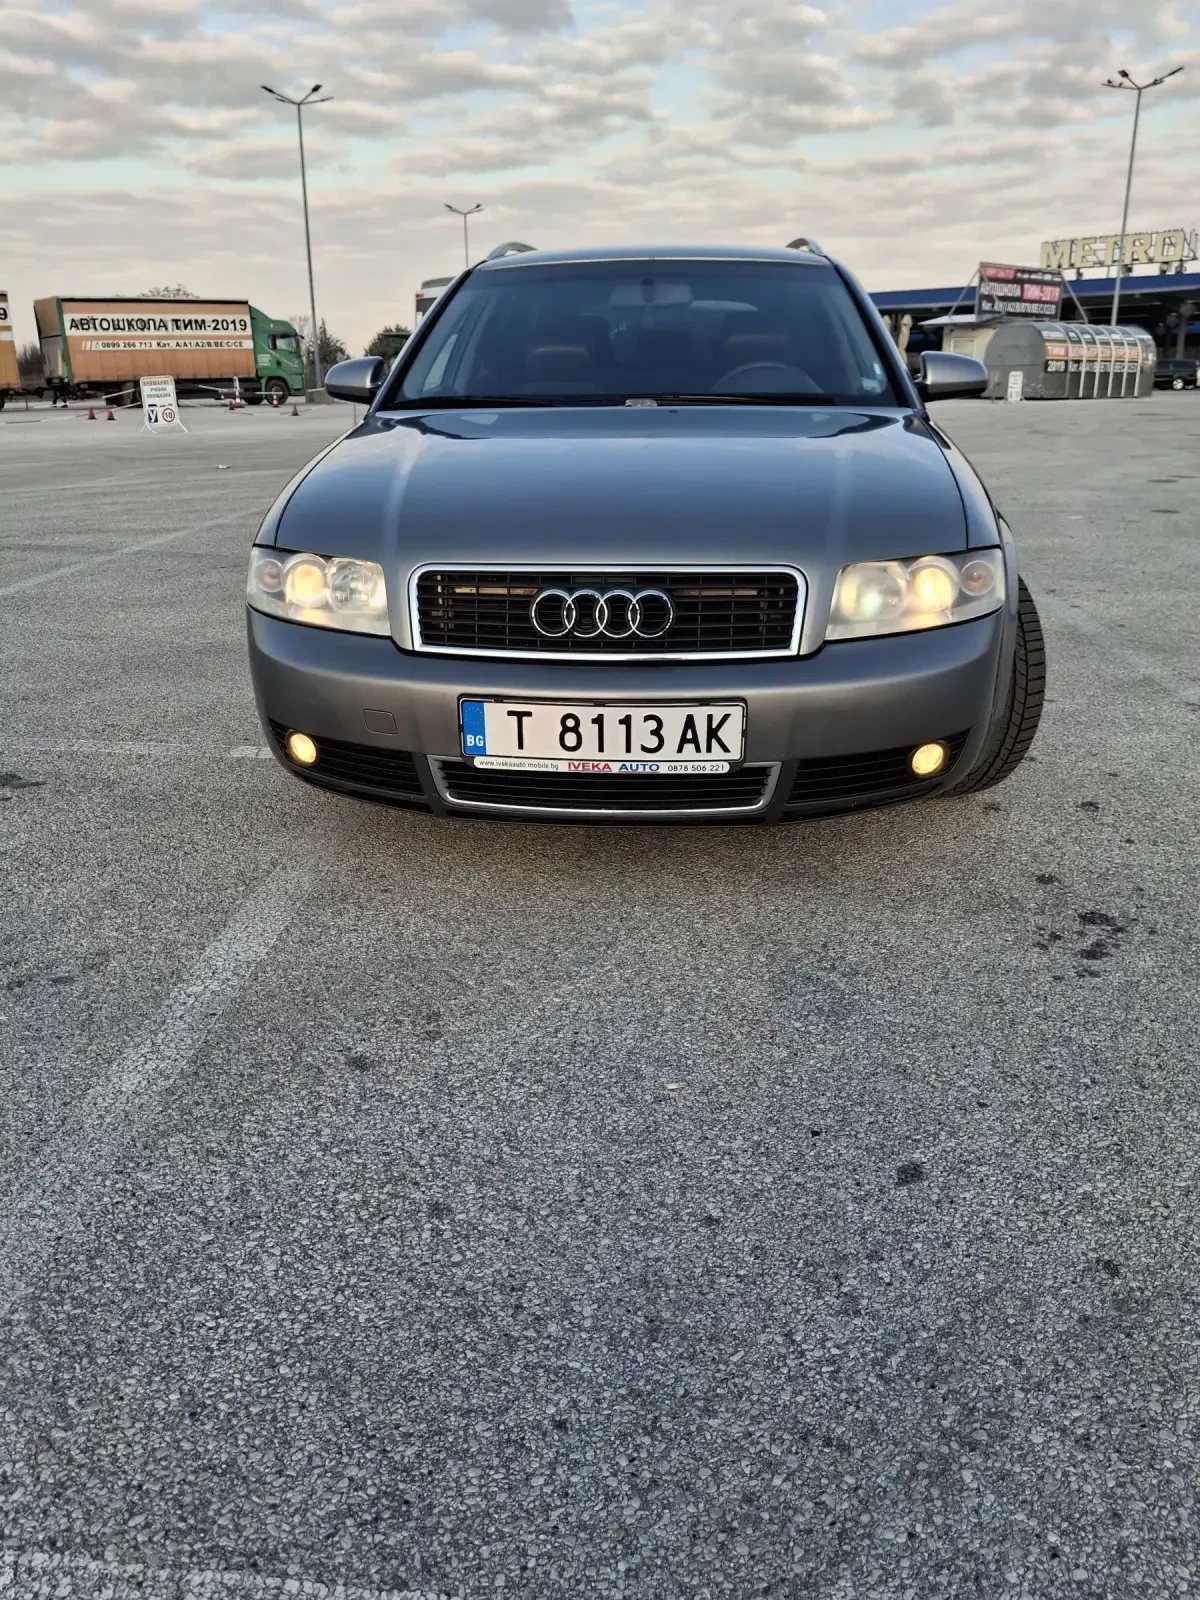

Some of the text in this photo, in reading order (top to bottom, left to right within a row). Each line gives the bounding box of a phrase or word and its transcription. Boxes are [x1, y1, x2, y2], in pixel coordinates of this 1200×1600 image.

[1041, 231, 1184, 269] METRO
[69, 316, 248, 332] АВТОШКОЛА ТИМ-2019
[165, 411, 173, 419] 10
[507, 710, 732, 754] T 8113 AK
[466, 734, 484, 747] BG
[568, 762, 612, 771] IVEKA
[618, 763, 660, 772] AUTO
